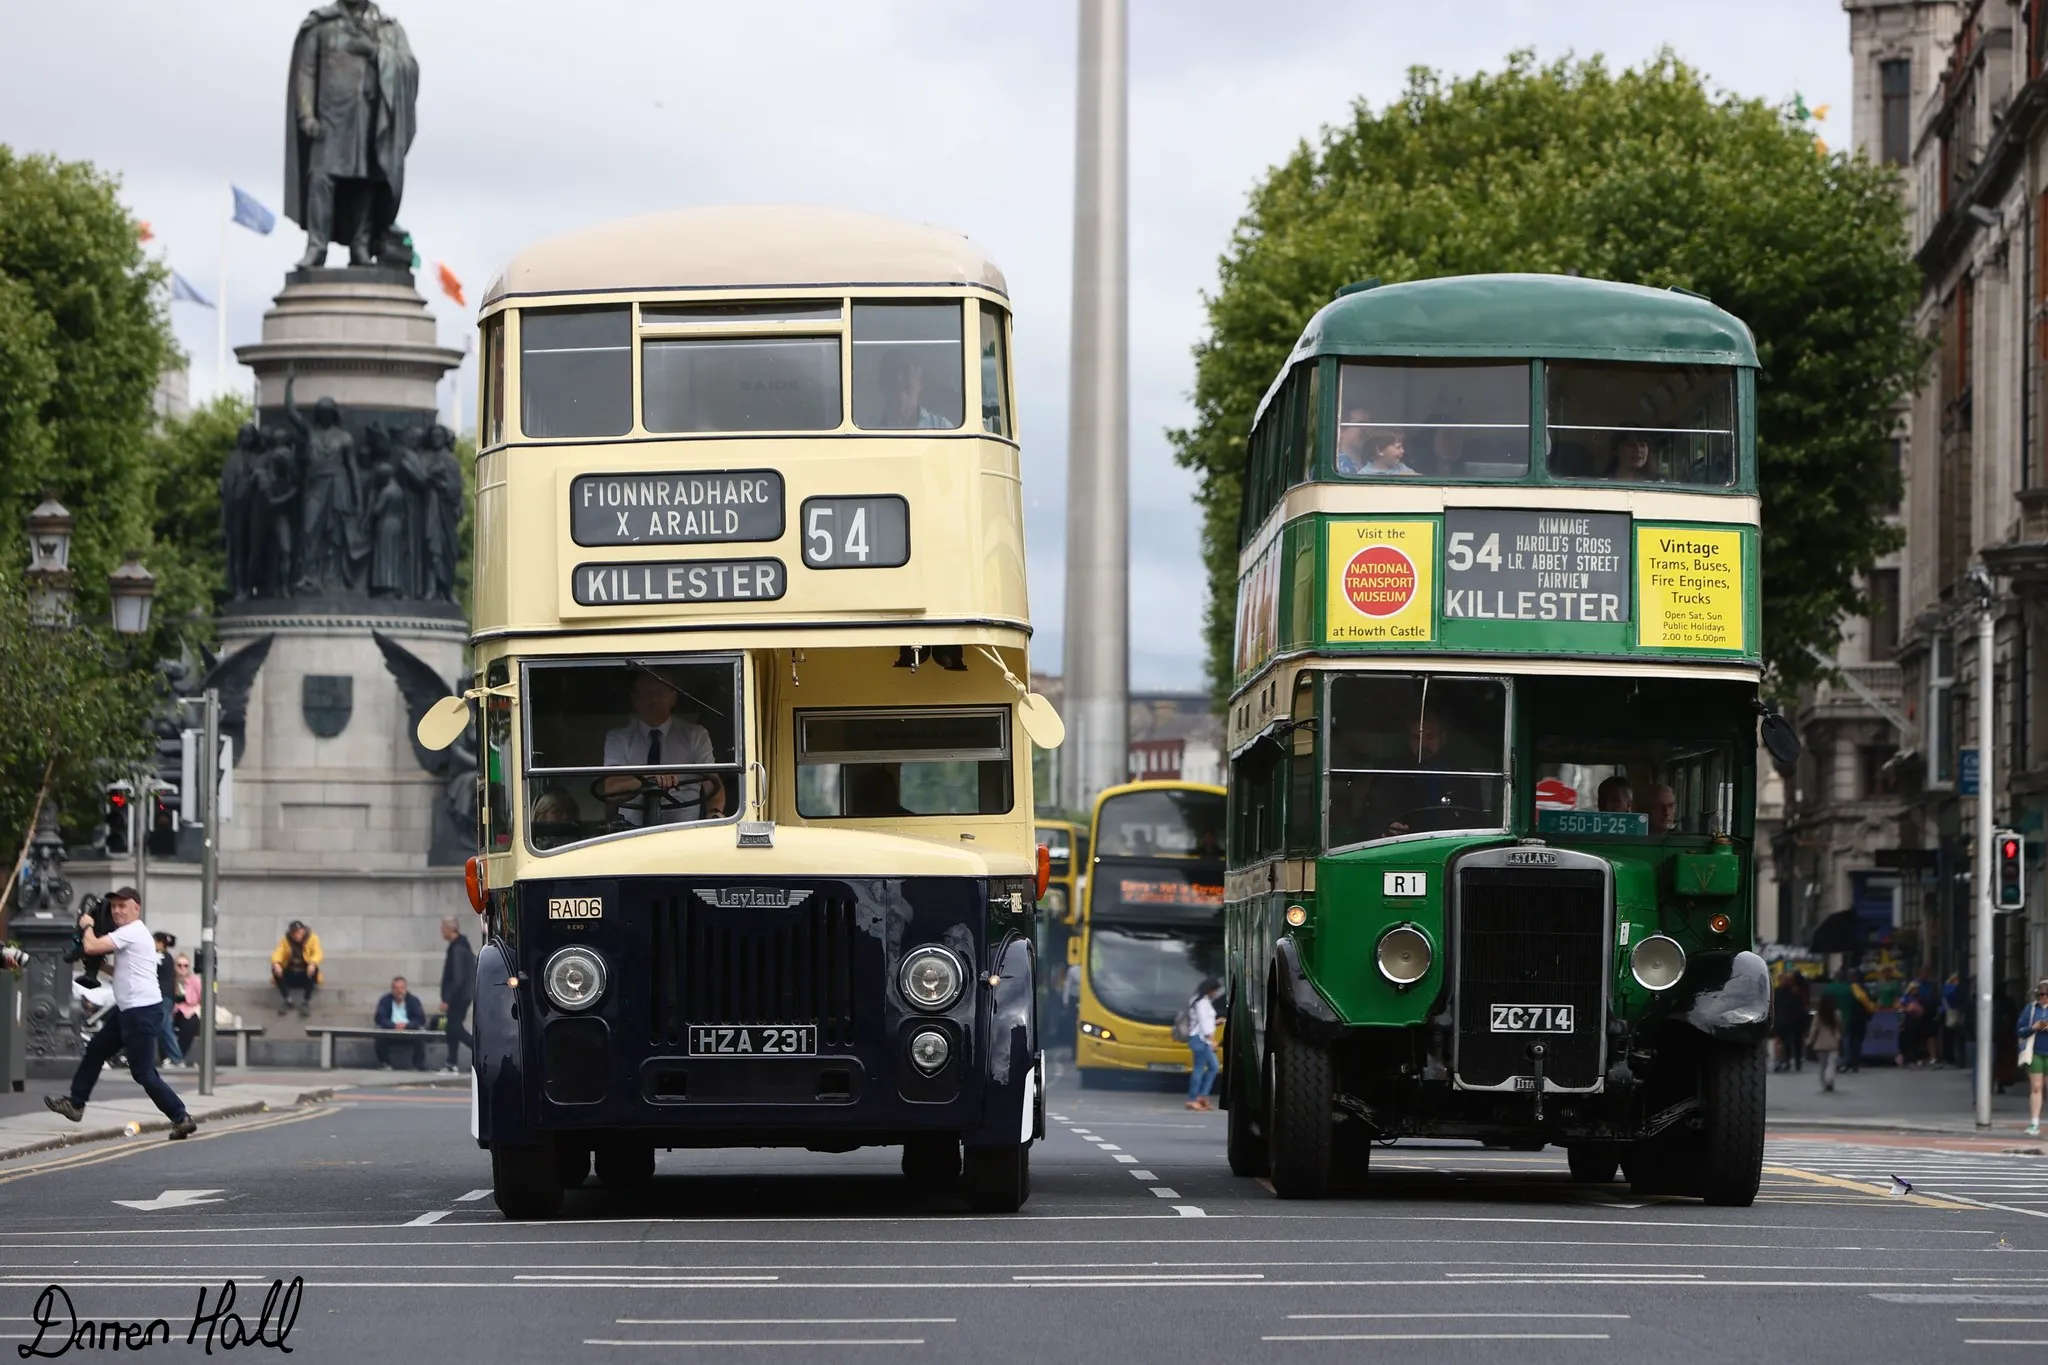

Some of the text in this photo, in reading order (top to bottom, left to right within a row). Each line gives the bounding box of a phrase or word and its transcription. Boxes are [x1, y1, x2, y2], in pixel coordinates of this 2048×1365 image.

[583, 479, 769, 507] FIONNRADHARC
[616, 509, 740, 536] X ARAILD
[1538, 517, 1591, 536] KIMMAGE
[807, 507, 870, 562] 54
[1356, 528, 1406, 539] Visit the
[1447, 531, 1503, 573] 54
[1516, 535, 1612, 554] HAROLD'S CROSS
[1659, 538, 1720, 558] Vintage
[1350, 563, 1411, 575] NATIONAL
[1508, 552, 1620, 573] LR. ABBEY STREET
[1649, 557, 1732, 573] Trams, Buses,
[587, 564, 776, 601] KILLESTER
[1345, 577, 1414, 588] TRANSPORT
[1537, 571, 1590, 590] FAIRVIEW
[1651, 574, 1731, 591] Fire Engines,
[1352, 590, 1407, 602] MUSEUM
[1446, 589, 1620, 622] KILLESTER
[1671, 591, 1712, 605] Trucks
[1664, 610, 1686, 621] Open
[1707, 612, 1723, 621] Sun
[1332, 625, 1426, 637] at Howth Castle
[1663, 621, 1726, 634] Public Holidays
[1662, 632, 1727, 644] 2.00 to 5.00pm
[1558, 815, 1628, 835] 550-D-25
[741, 836, 769, 844] LEYLAND
[1508, 852, 1557, 865] LEYLAND
[1395, 875, 1405, 893] R
[550, 898, 601, 918] RA106
[720, 888, 786, 909] Leyland
[699, 1029, 807, 1053] HZA 231
